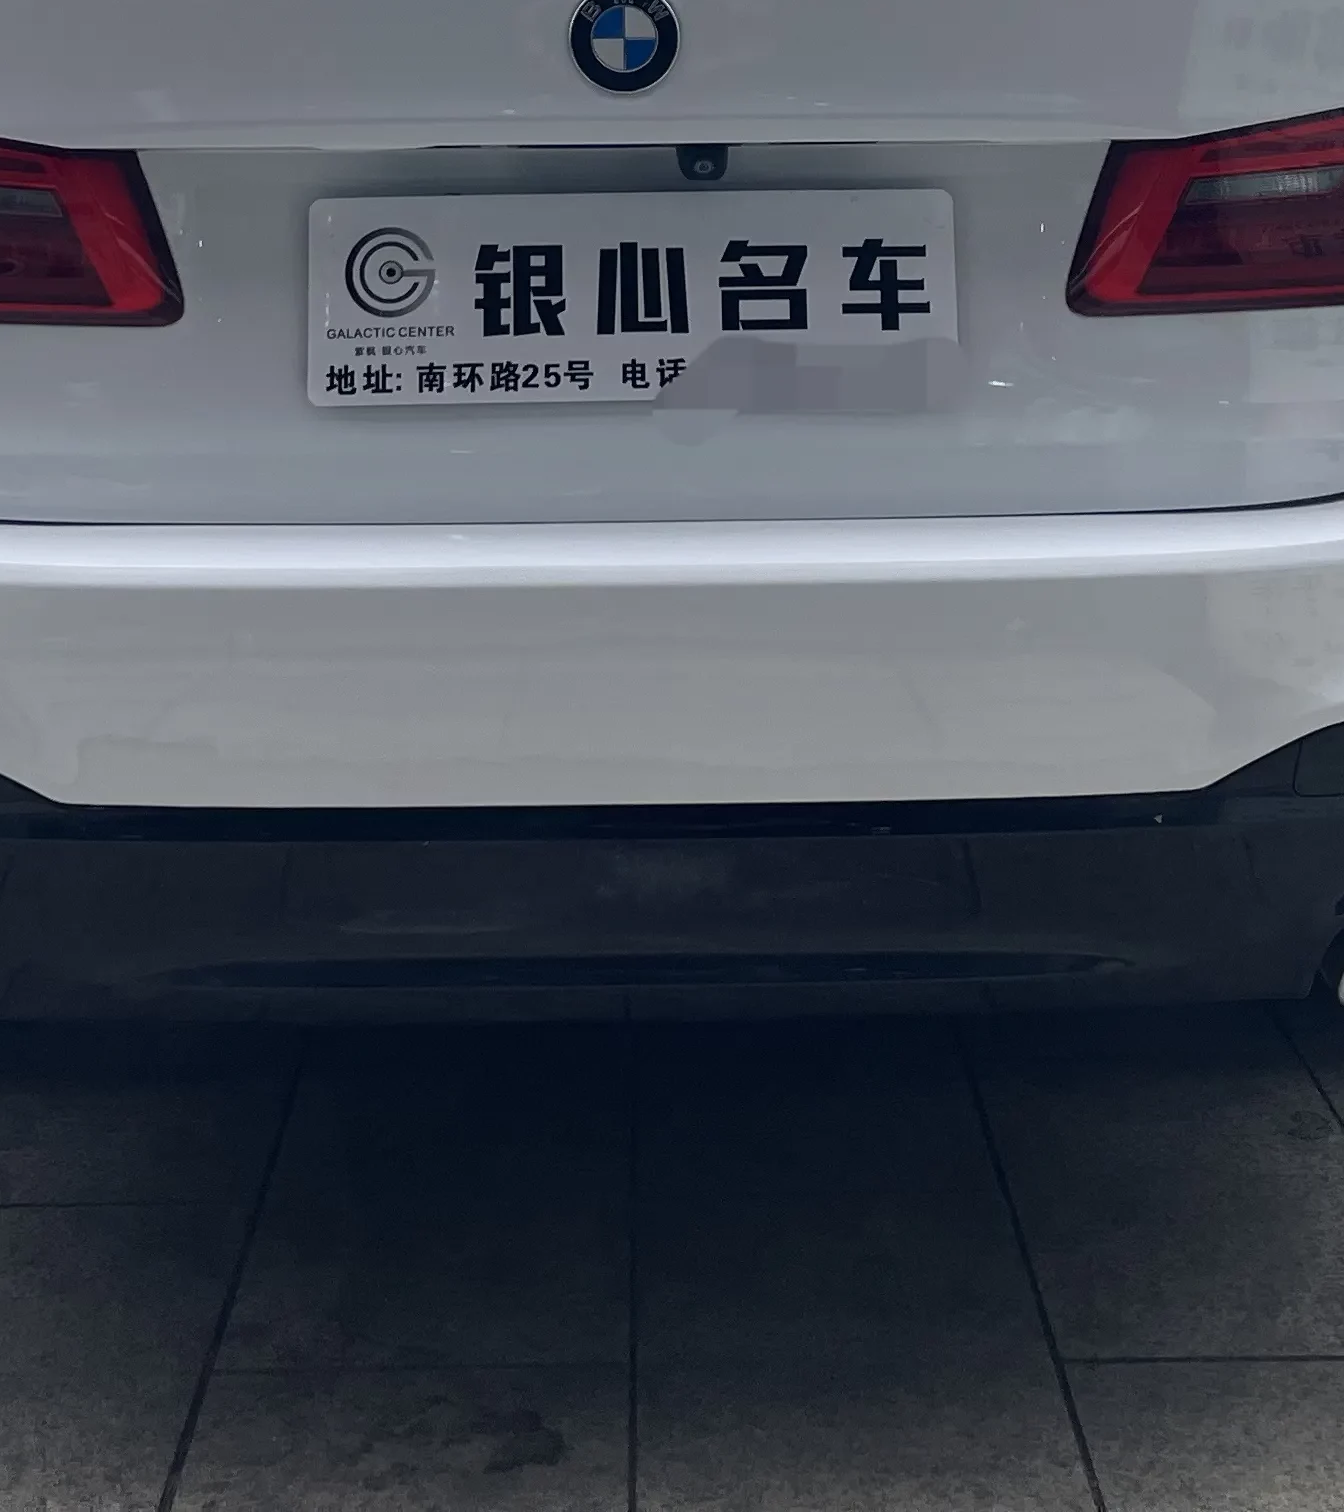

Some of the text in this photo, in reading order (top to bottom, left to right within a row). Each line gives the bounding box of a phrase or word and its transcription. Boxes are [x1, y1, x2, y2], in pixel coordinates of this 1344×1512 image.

[473, 238, 931, 337] 银心名车
[326, 325, 456, 340] GALACTIC CENTER
[416, 360, 594, 393] 南环路25号
